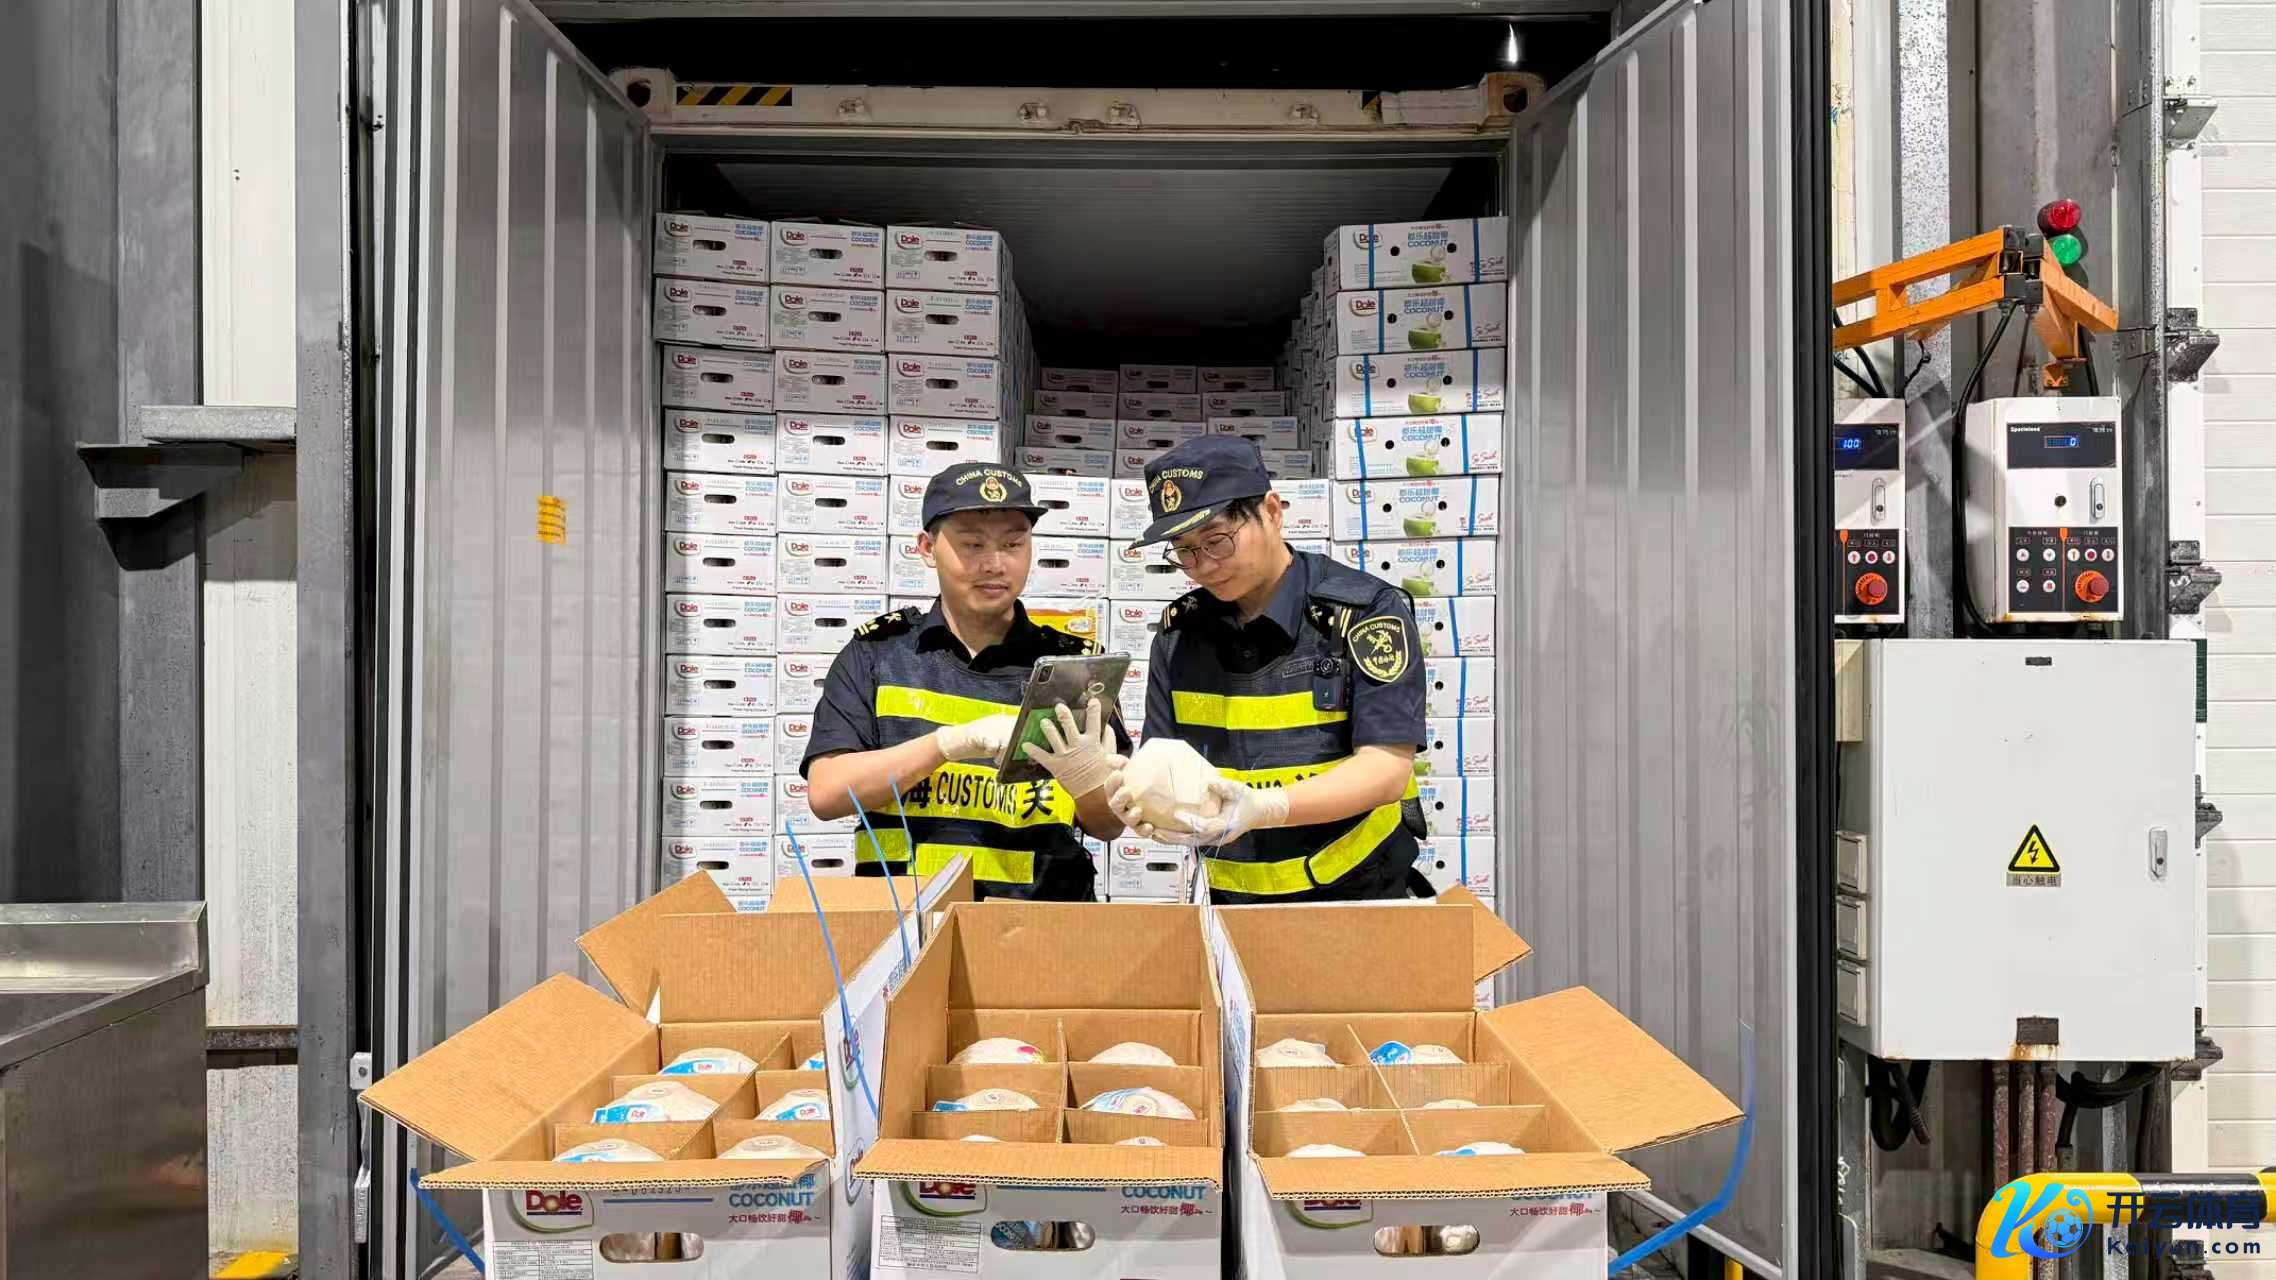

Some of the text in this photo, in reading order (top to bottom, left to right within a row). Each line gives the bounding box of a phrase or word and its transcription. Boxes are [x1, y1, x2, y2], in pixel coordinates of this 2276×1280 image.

[1355, 300, 1376, 310] Dole
[1404, 306, 1444, 314] COCONUT
[903, 423, 922, 433] Dole
[1402, 434, 1441, 442] COCONUT
[1843, 438, 1860, 448] 100
[955, 468, 1023, 488] CHINA CUSTOMS
[1161, 468, 1204, 480] CUSTOMS
[1125, 486, 1143, 497] Dole
[1399, 495, 1439, 503] COCONUT
[905, 544, 921, 554] Dol
[1124, 608, 1143, 618] Dole
[1369, 622, 1400, 633] CUSTOMS
[789, 722, 807, 732] Dole
[935, 771, 1018, 815] CUSTOMS
[1122, 1186, 1206, 1200] COCONUT
[526, 1190, 583, 1212] Dole
[729, 1192, 814, 1207] COCONUT
